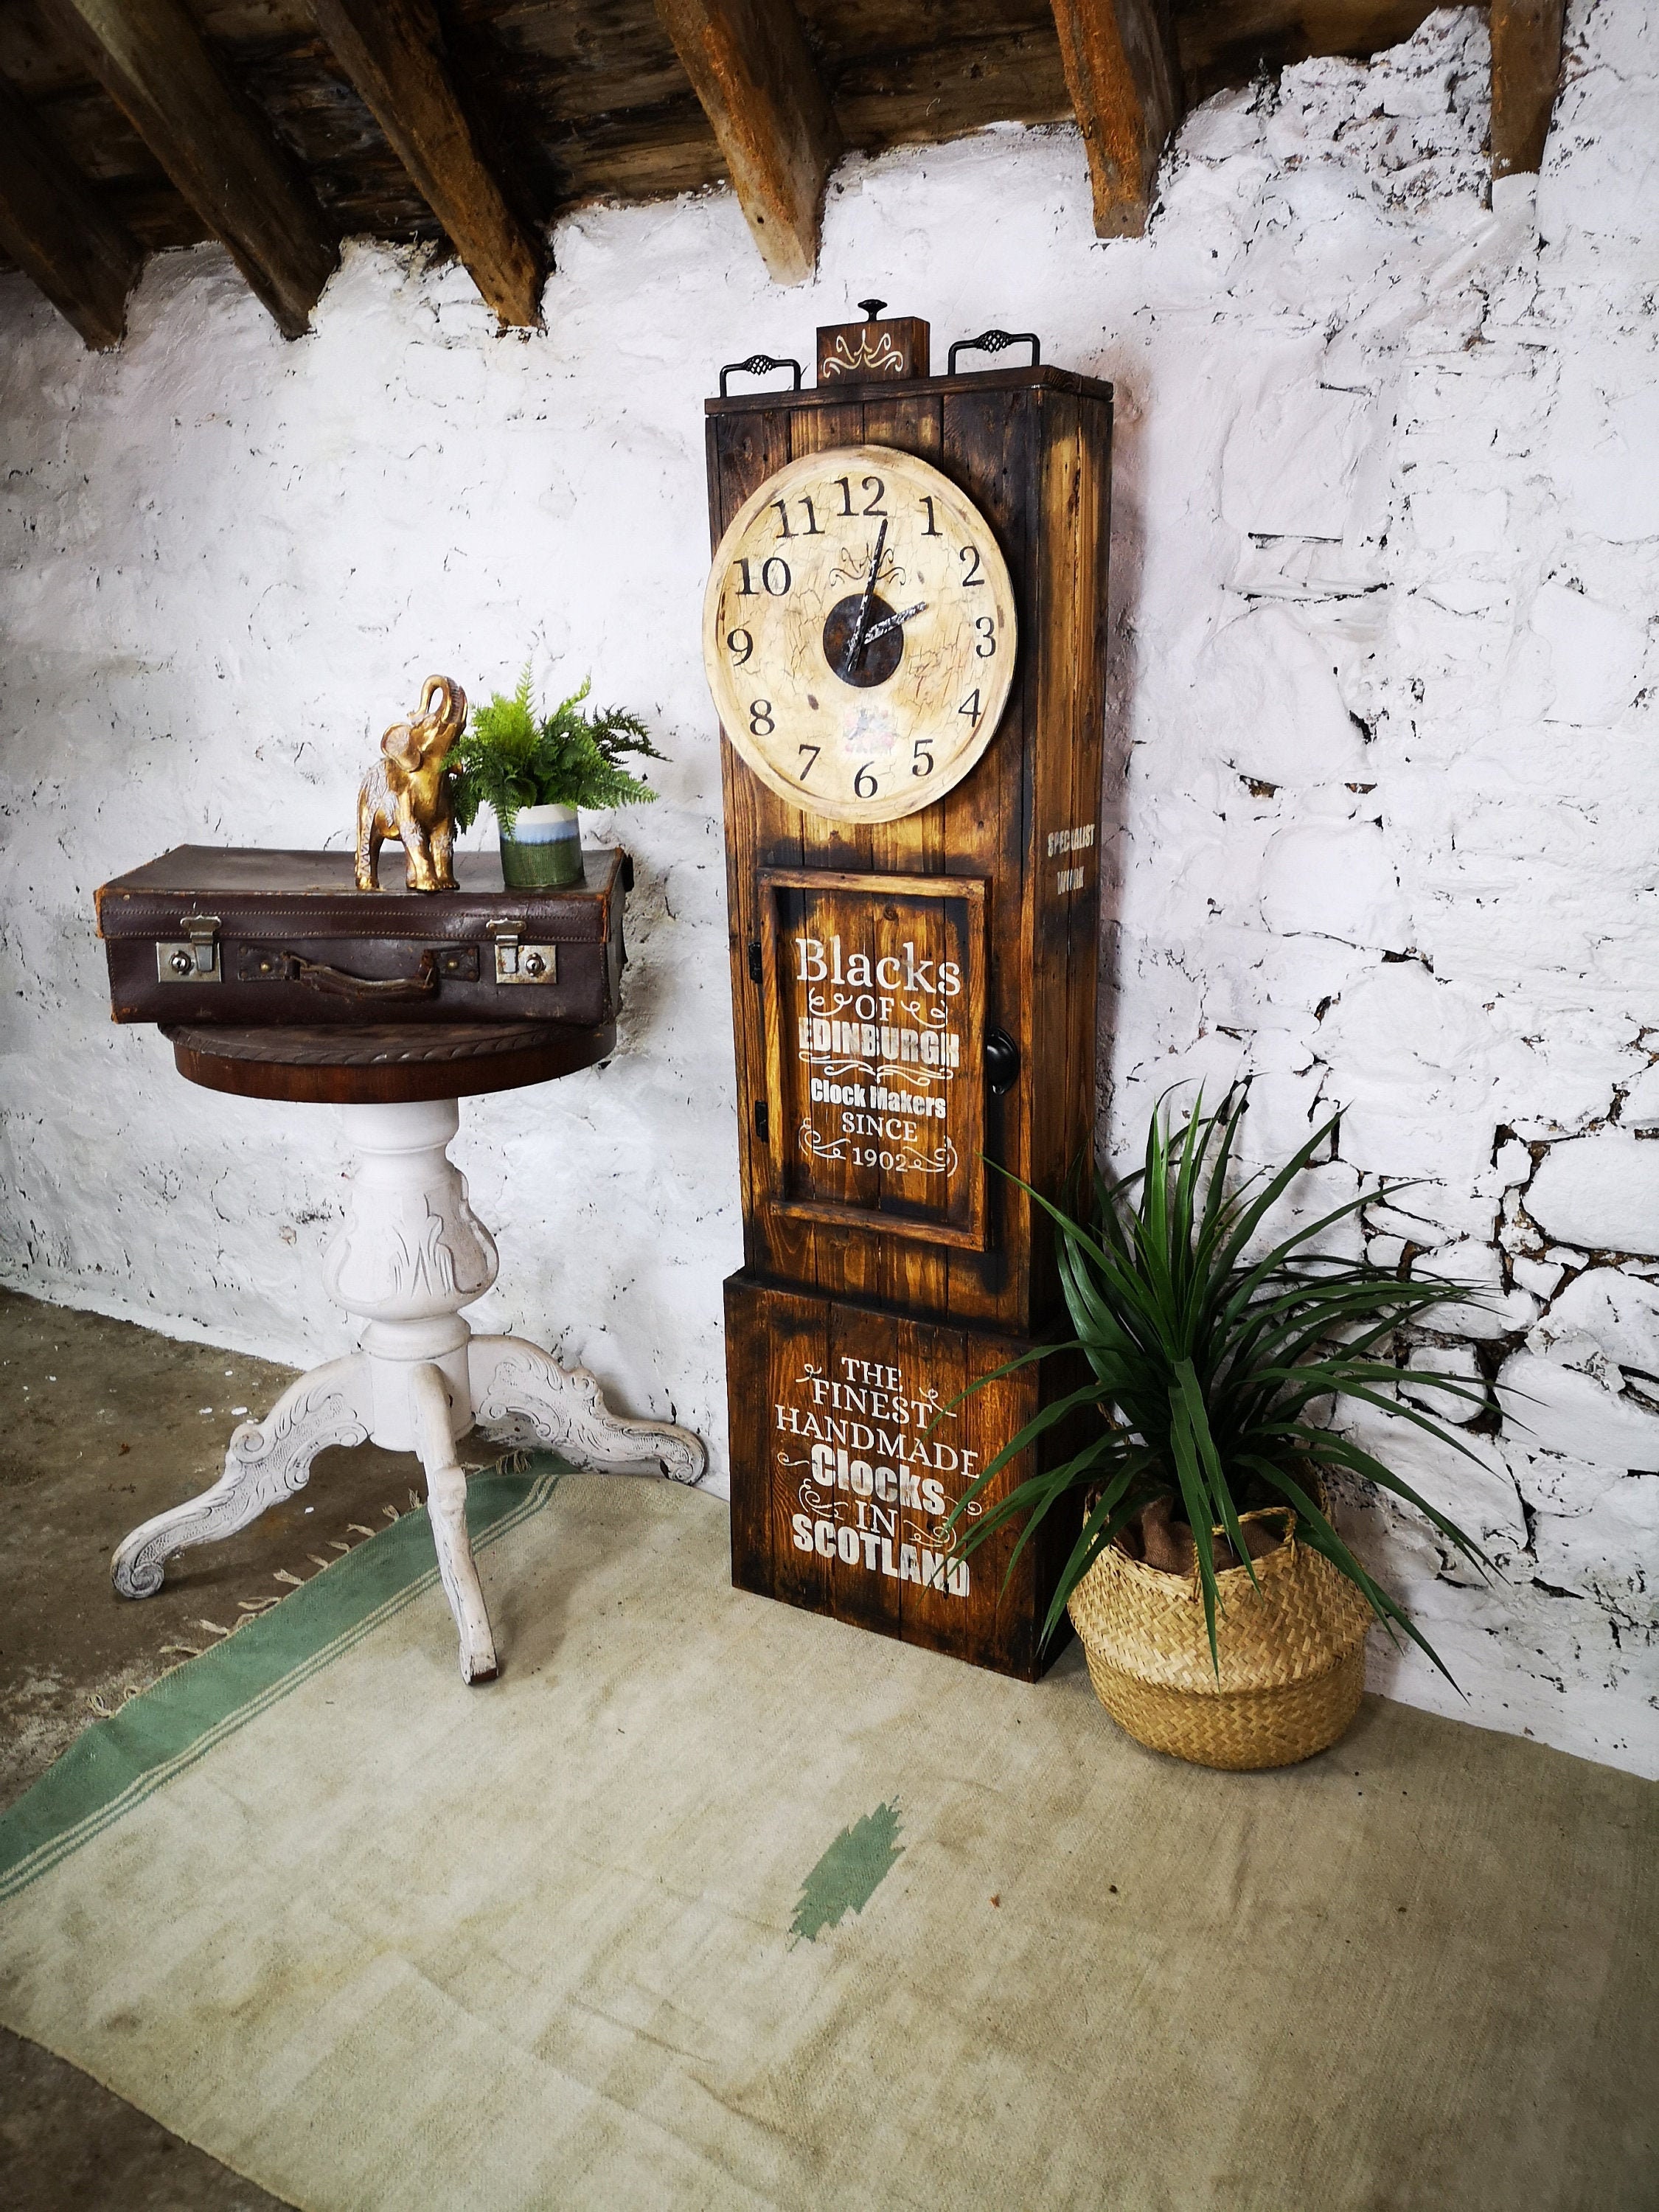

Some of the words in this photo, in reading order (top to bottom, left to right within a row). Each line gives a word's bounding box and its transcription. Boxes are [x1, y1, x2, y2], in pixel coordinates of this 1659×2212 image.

[771, 495, 825, 539] 11
[835, 476, 888, 517] 12
[919, 495, 943, 537] 1
[733, 556, 792, 597] 10
[959, 546, 985, 587] 2
[726, 627, 754, 666] 9
[975, 616, 996, 658] 3
[749, 699, 775, 736] 8
[959, 688, 981, 728] 4
[799, 743, 821, 781] 7
[911, 739, 933, 776] 5
[854, 761, 878, 799] 6
[795, 935, 961, 995] Blacks
[855, 994, 894, 1021] OF
[799, 1017, 959, 1068] EDINBURGH
[811, 1077, 866, 1107] Clock
[870, 1086, 947, 1119] Makers
[842, 1112, 918, 1142] SINCE
[852, 1147, 908, 1172] 1902
[841, 1357, 902, 1392] THE
[812, 1378, 933, 1429] FINEST
[774, 1403, 980, 1479] HANDMADE
[855, 1500, 898, 1537] IN
[793, 1513, 970, 1598] SCOTLAND
